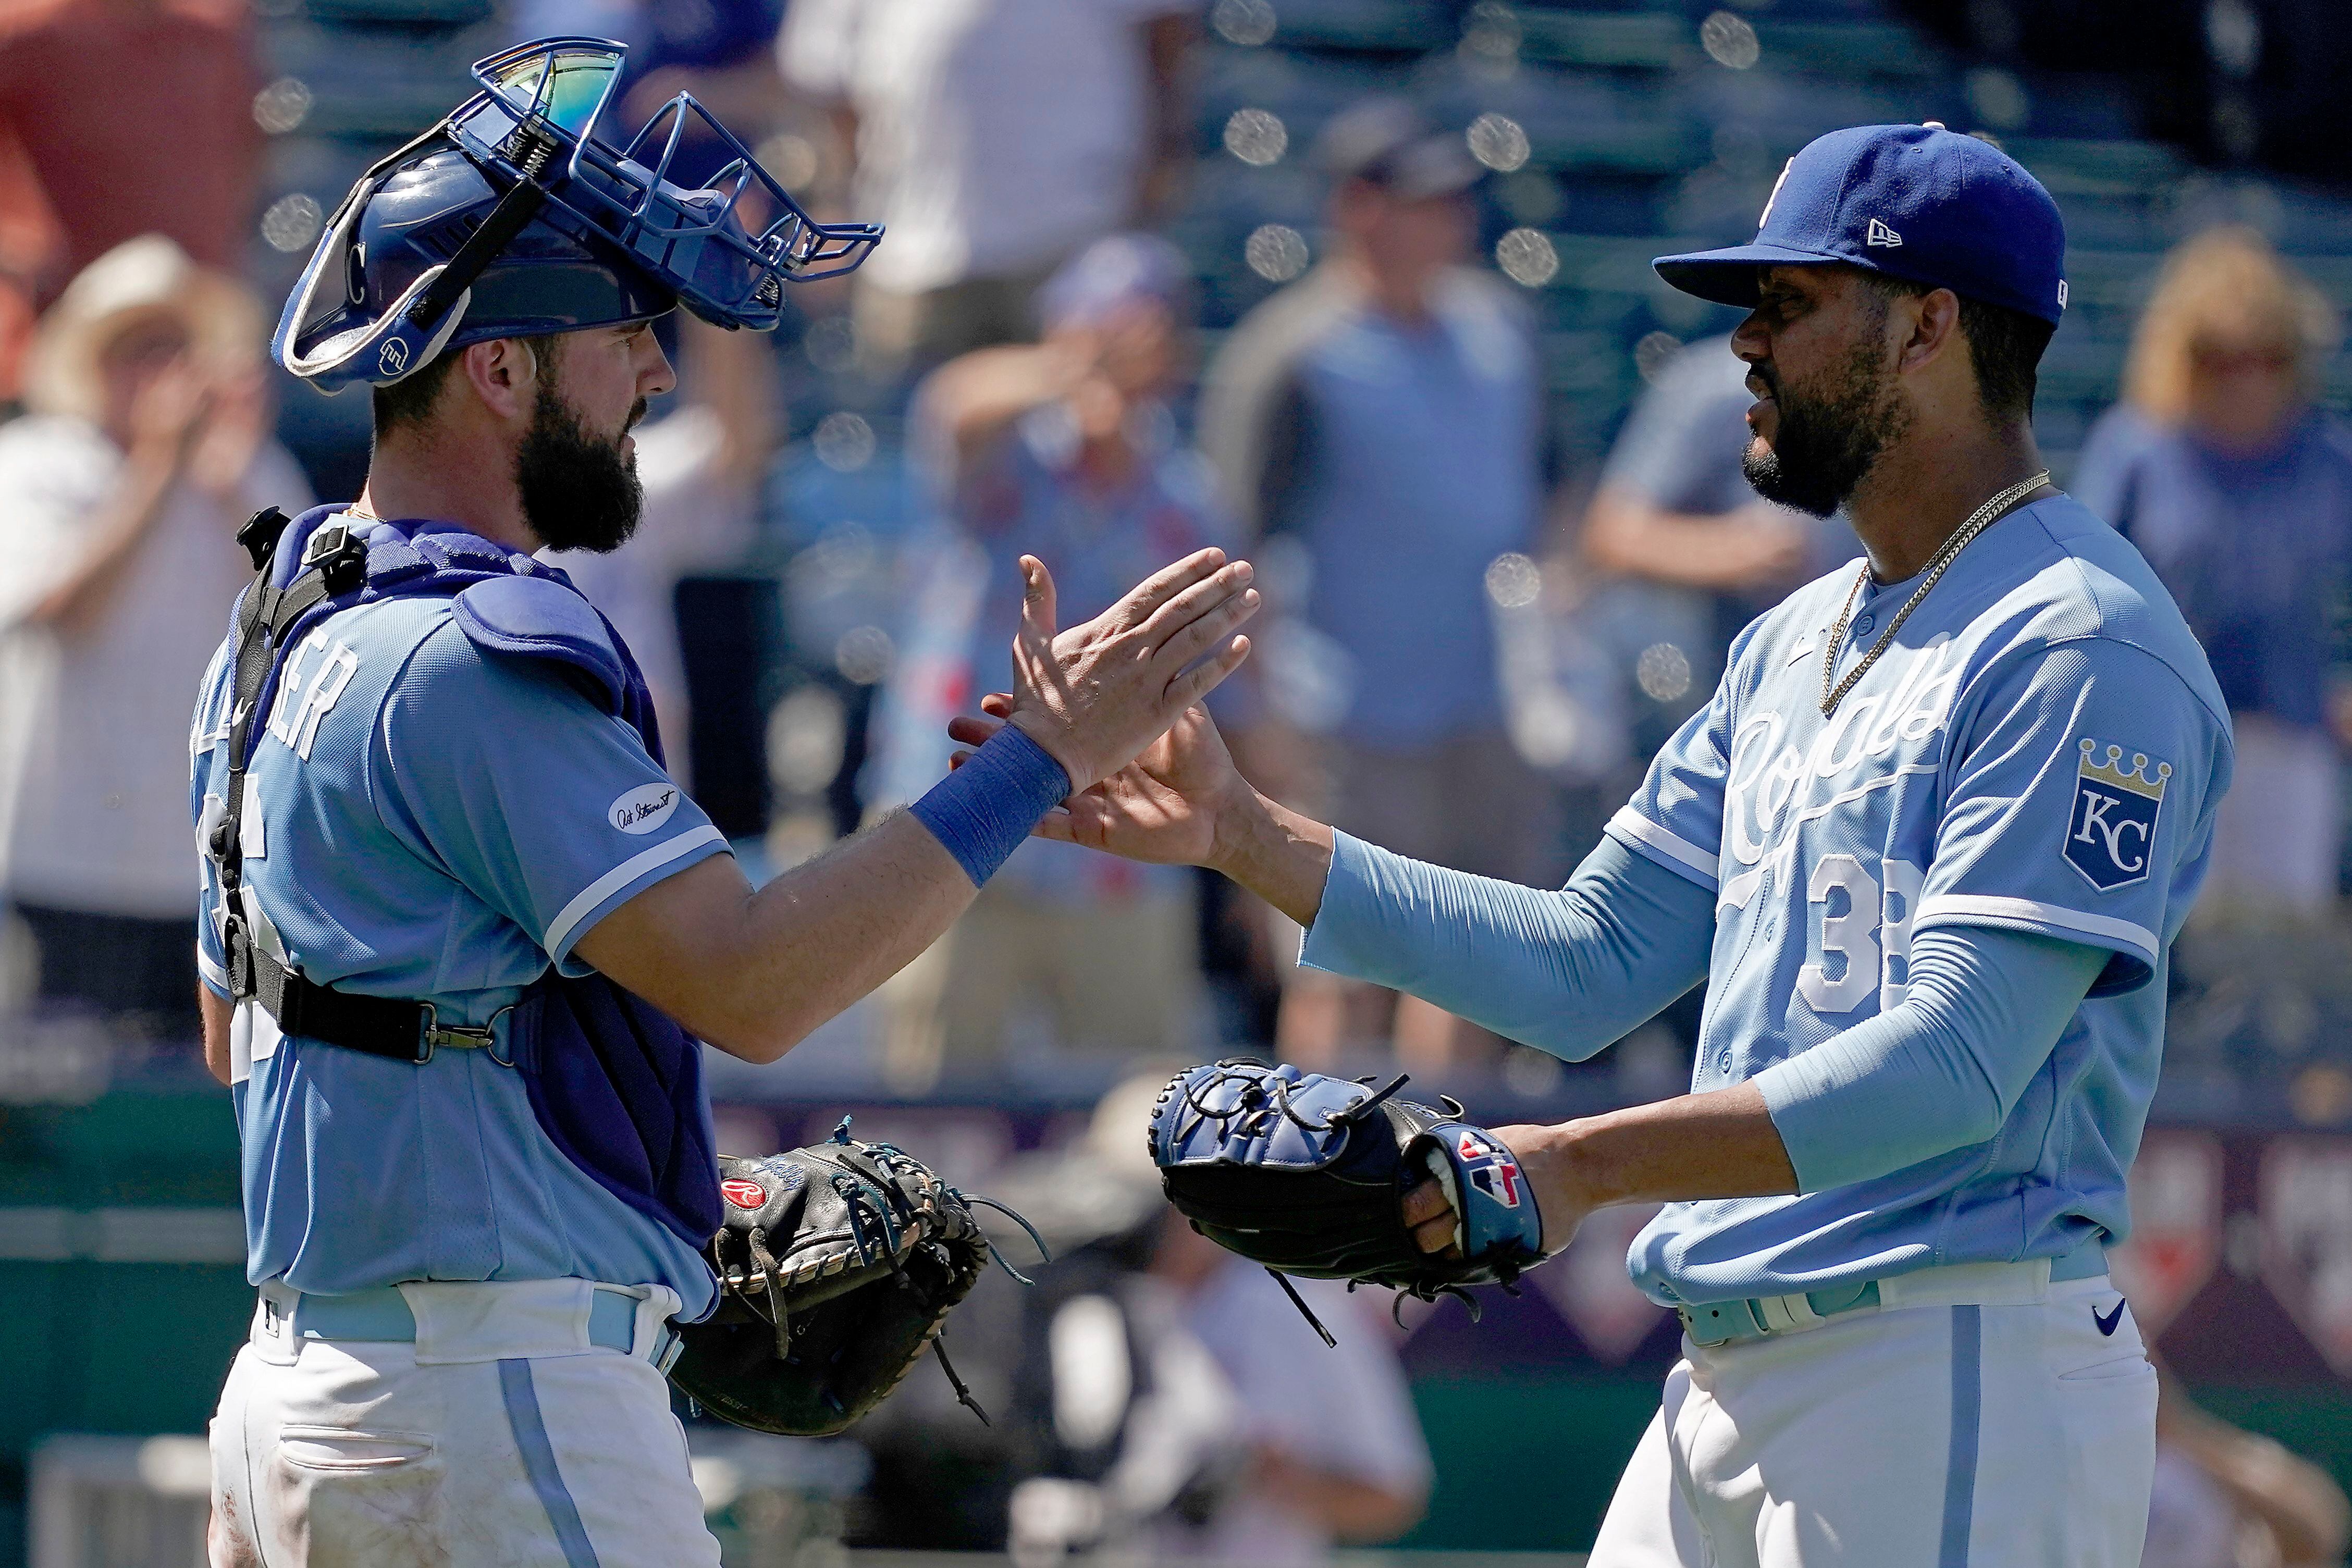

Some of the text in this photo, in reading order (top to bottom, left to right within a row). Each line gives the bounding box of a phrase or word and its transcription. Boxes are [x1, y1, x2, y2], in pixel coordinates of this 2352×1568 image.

[266, 625, 359, 762] ER
[1724, 631, 1963, 898] Royals
[2074, 789, 2148, 872] KC
